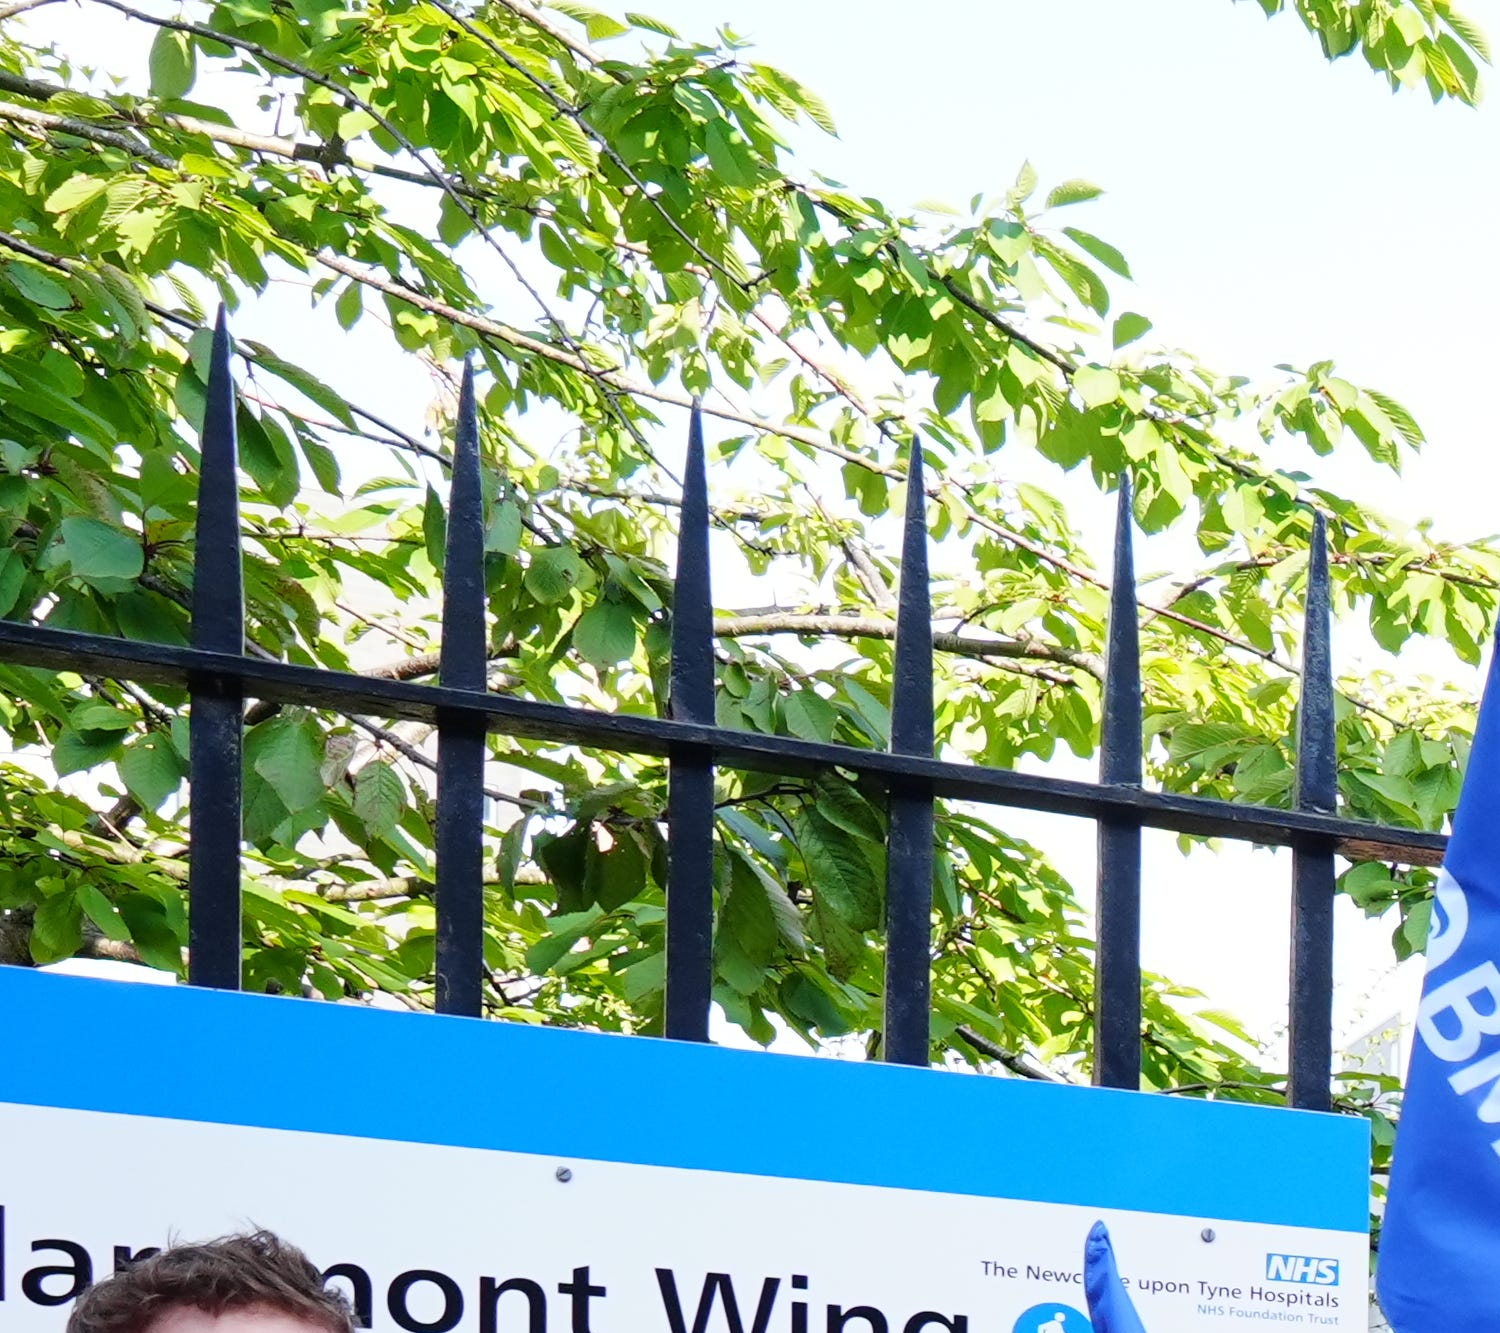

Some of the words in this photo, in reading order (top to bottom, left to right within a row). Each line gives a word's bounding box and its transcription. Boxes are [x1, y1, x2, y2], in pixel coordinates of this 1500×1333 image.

[981, 1260, 1018, 1279] The
[1027, 1265, 1130, 1289] Newce
[1139, 1279, 1189, 1296] upon
[1198, 1281, 1242, 1301] Tyne
[1250, 1286, 1339, 1308] Hospitals
[1268, 1255, 1338, 1284] NHS
[1197, 1304, 1225, 1316] NHS
[1229, 1306, 1304, 1323] Foundation
[1308, 1312, 1339, 1326] Trust
